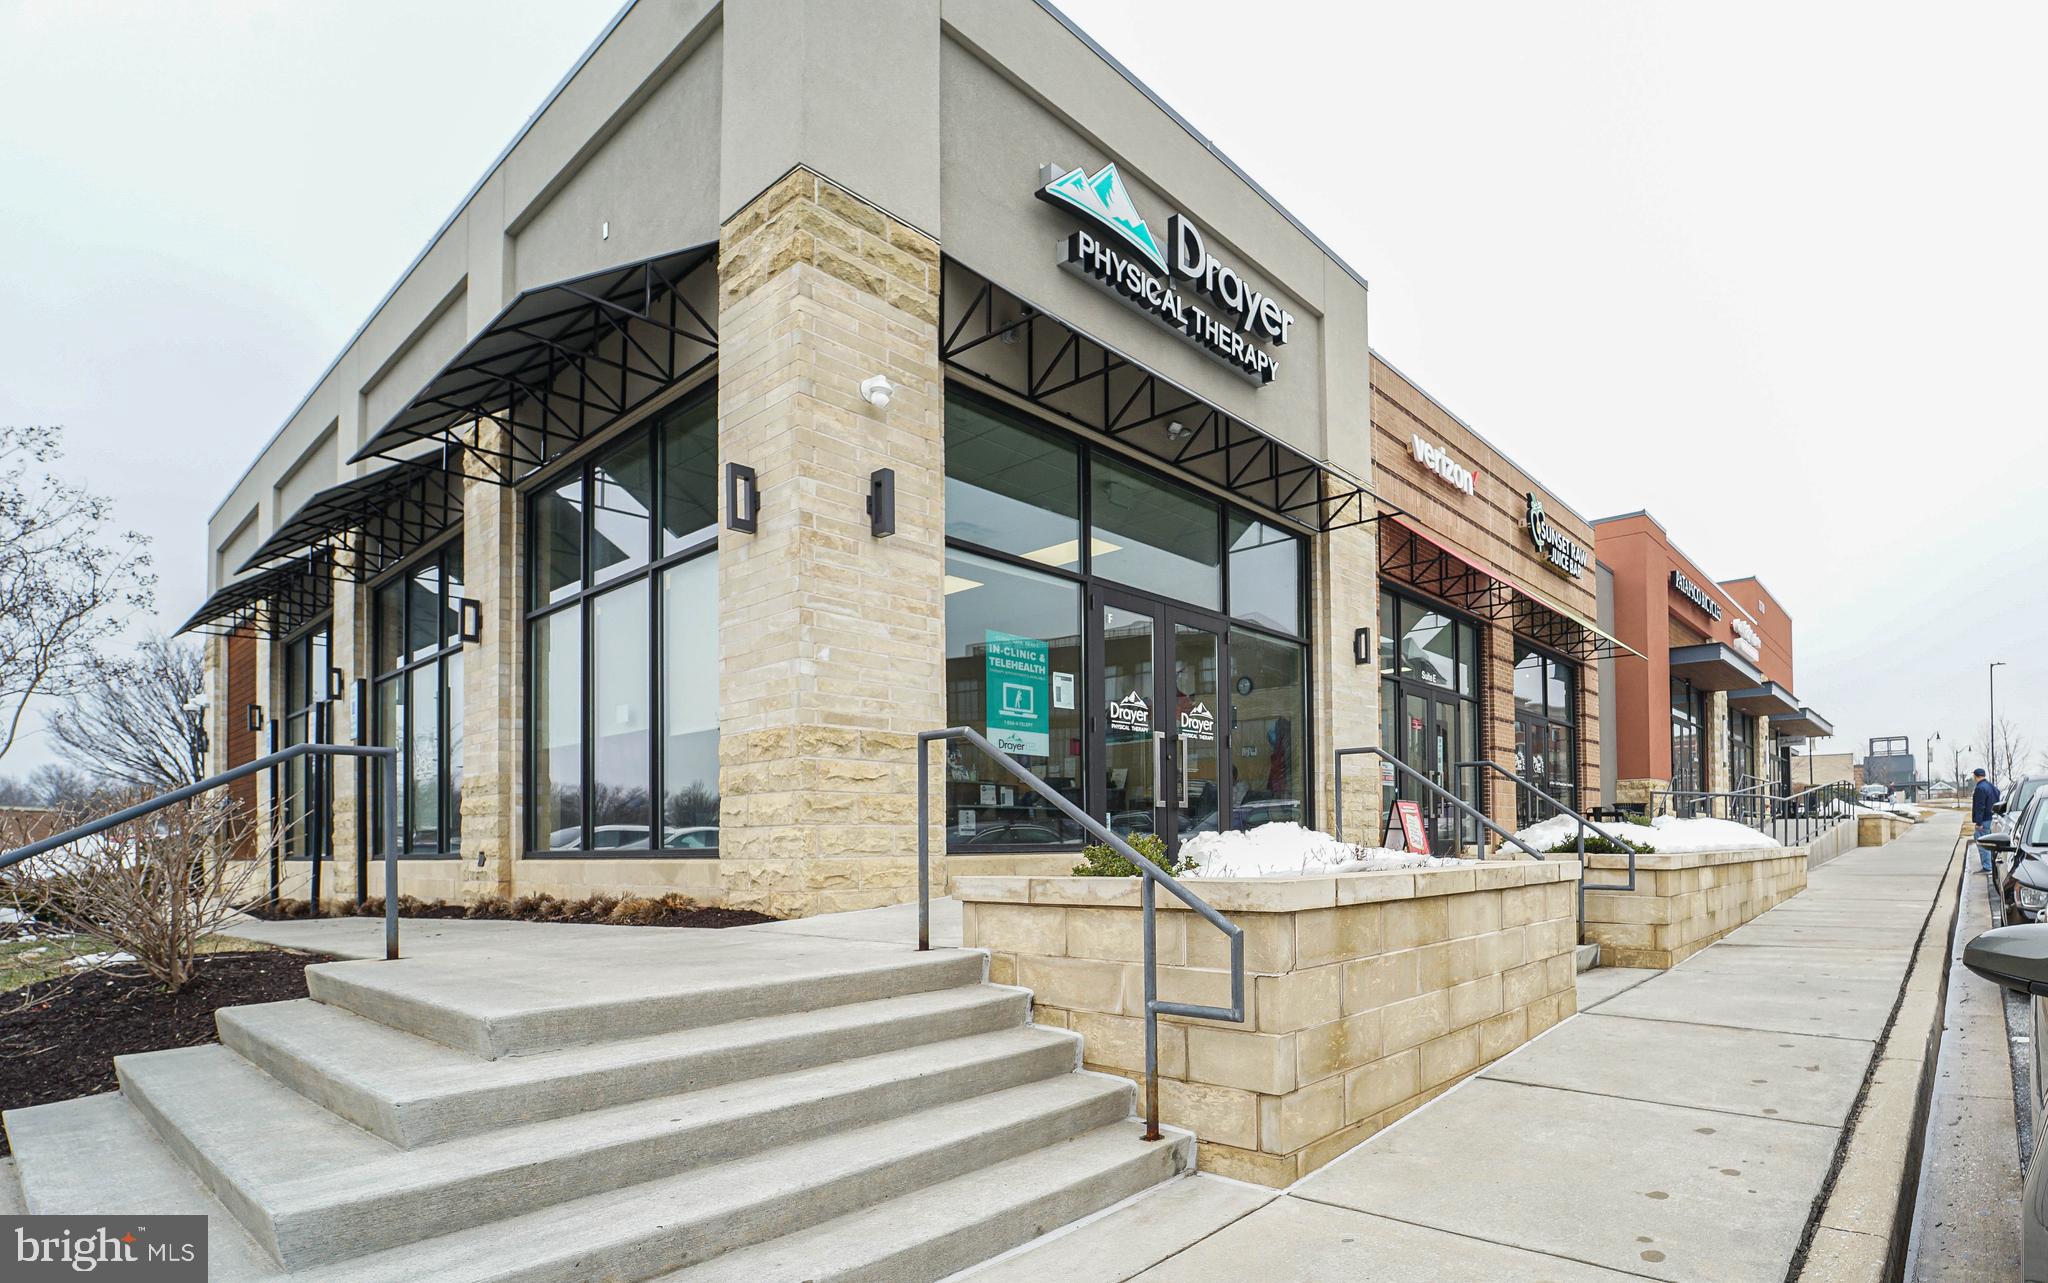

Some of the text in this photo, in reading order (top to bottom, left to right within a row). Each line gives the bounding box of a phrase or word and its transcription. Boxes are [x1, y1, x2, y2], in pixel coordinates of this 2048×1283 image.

[1177, 213, 1294, 344] Drayer
[1078, 230, 1279, 381] PHYSICAL THERAPY
[1411, 433, 1476, 496] verizon
[1541, 520, 1588, 567] SUNSET RAW
[1551, 547, 1583, 579] JUICE BAR
[989, 643, 1037, 661] IN-CLINIC
[1039, 653, 1045, 663] &
[989, 656, 1046, 675] TELEHEALTH
[1421, 670, 1433, 682] Suite
[1110, 701, 1149, 724] Drayer
[1181, 712, 1214, 733] Drayer
[1111, 723, 1149, 733] PHYSICAL THERAPY
[998, 738, 1025, 752] Drayer
